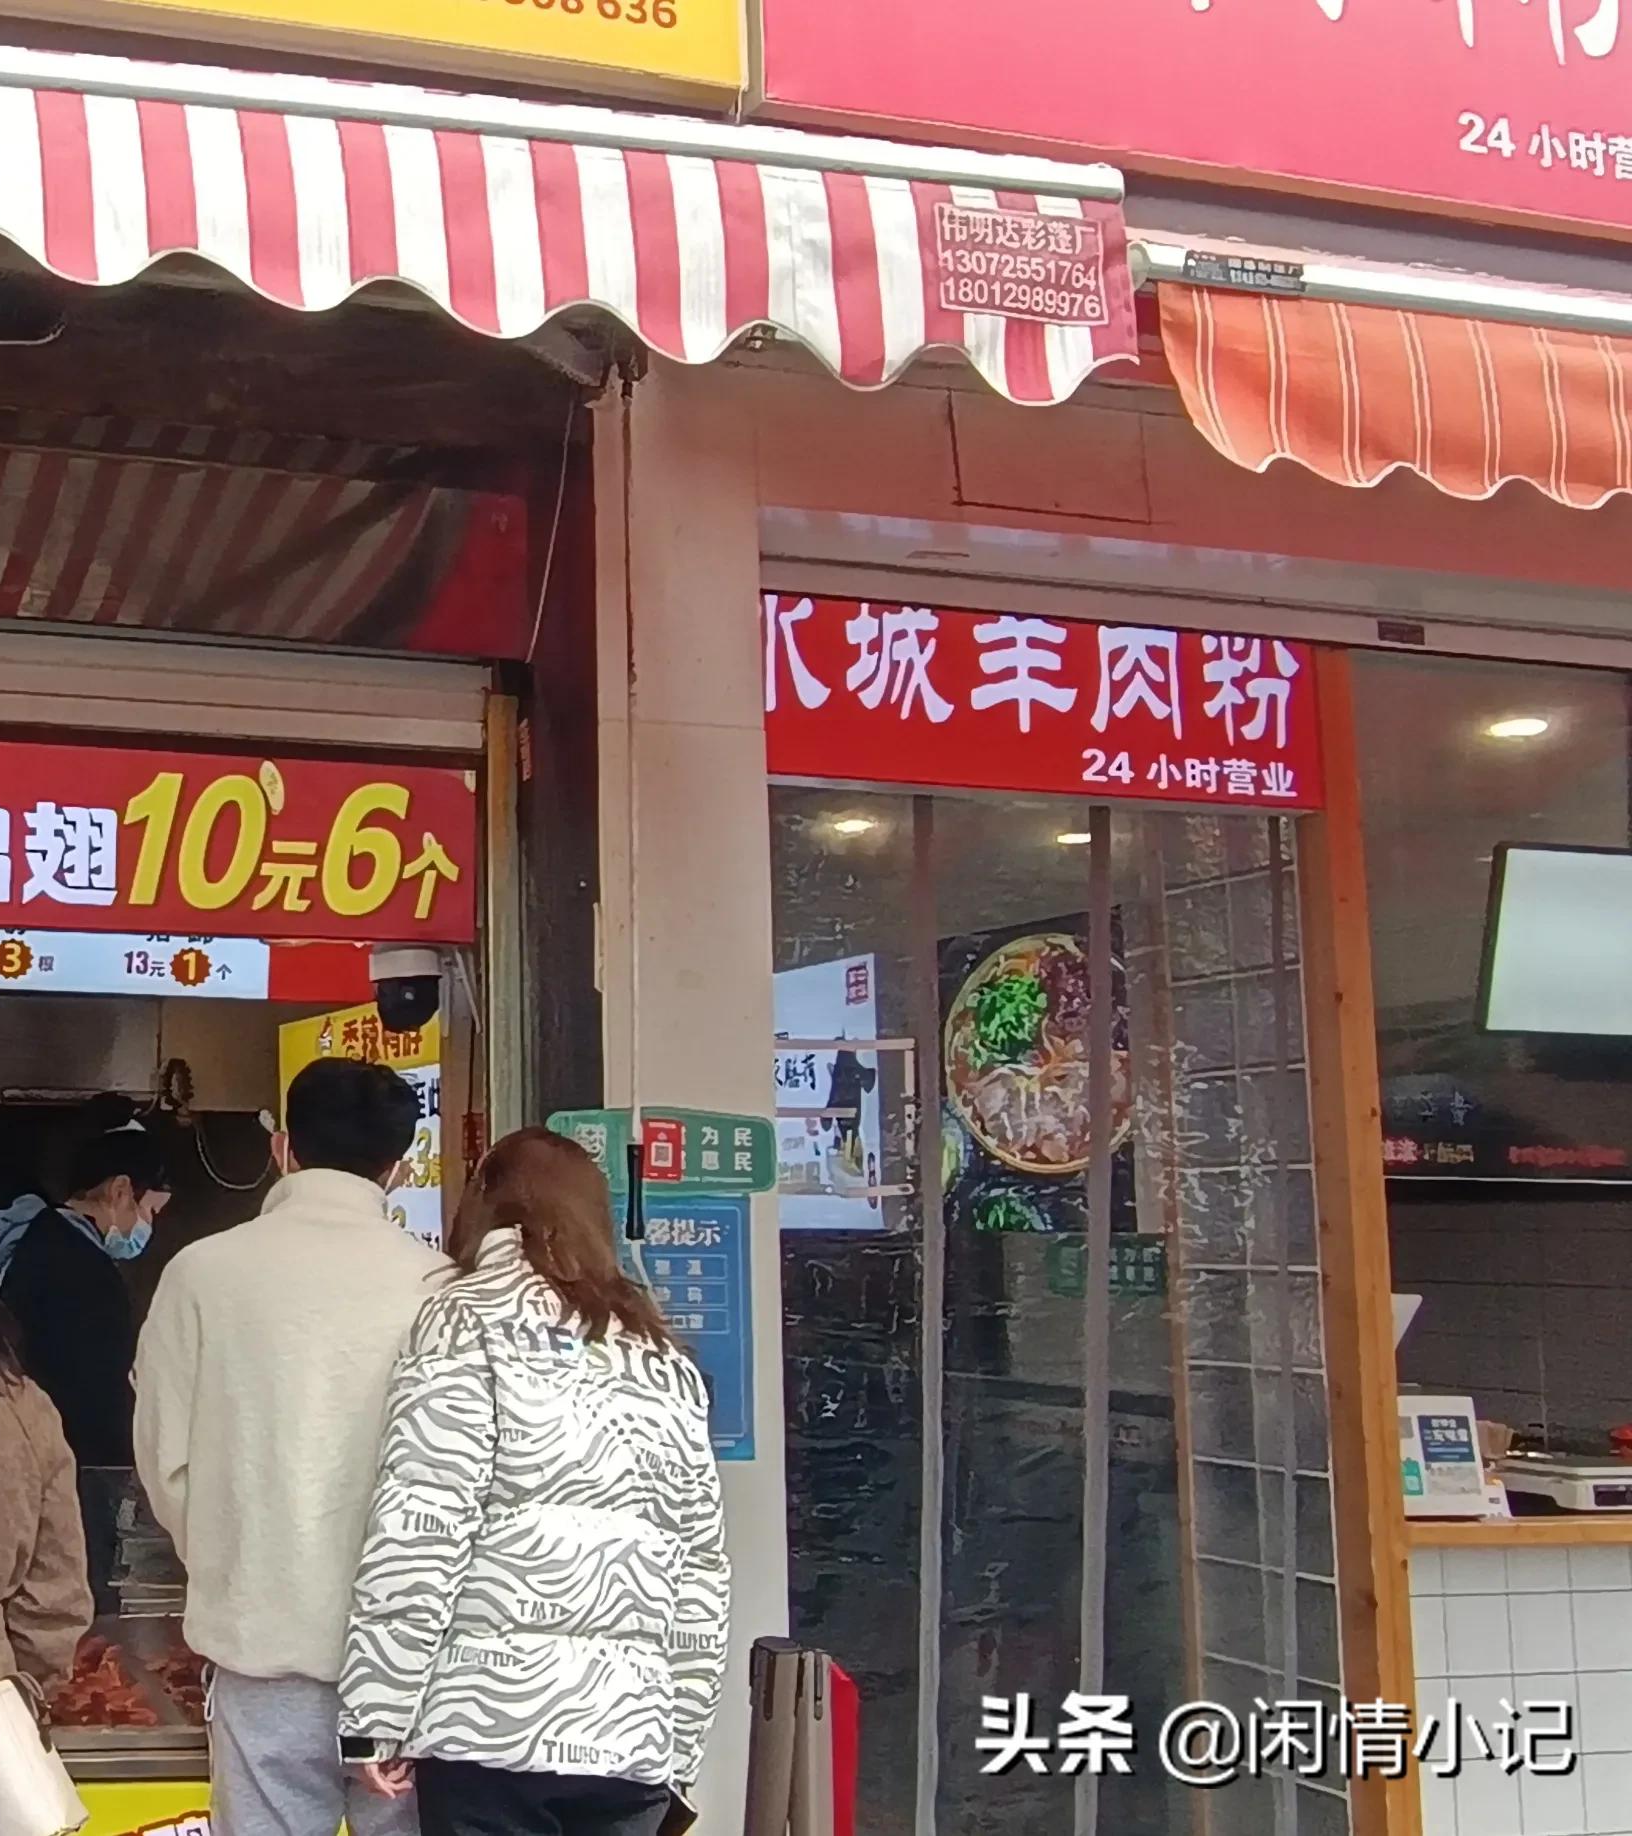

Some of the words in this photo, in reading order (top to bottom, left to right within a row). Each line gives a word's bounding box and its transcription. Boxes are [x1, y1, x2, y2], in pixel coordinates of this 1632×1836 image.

[1457, 111, 1516, 158] 24
[941, 249, 1097, 292] 13072551764
[944, 277, 1101, 318] 18012989976
[1081, 748, 1135, 785] 24
[1146, 753, 1298, 798] 小时营业
[122, 771, 460, 920] 10元6个
